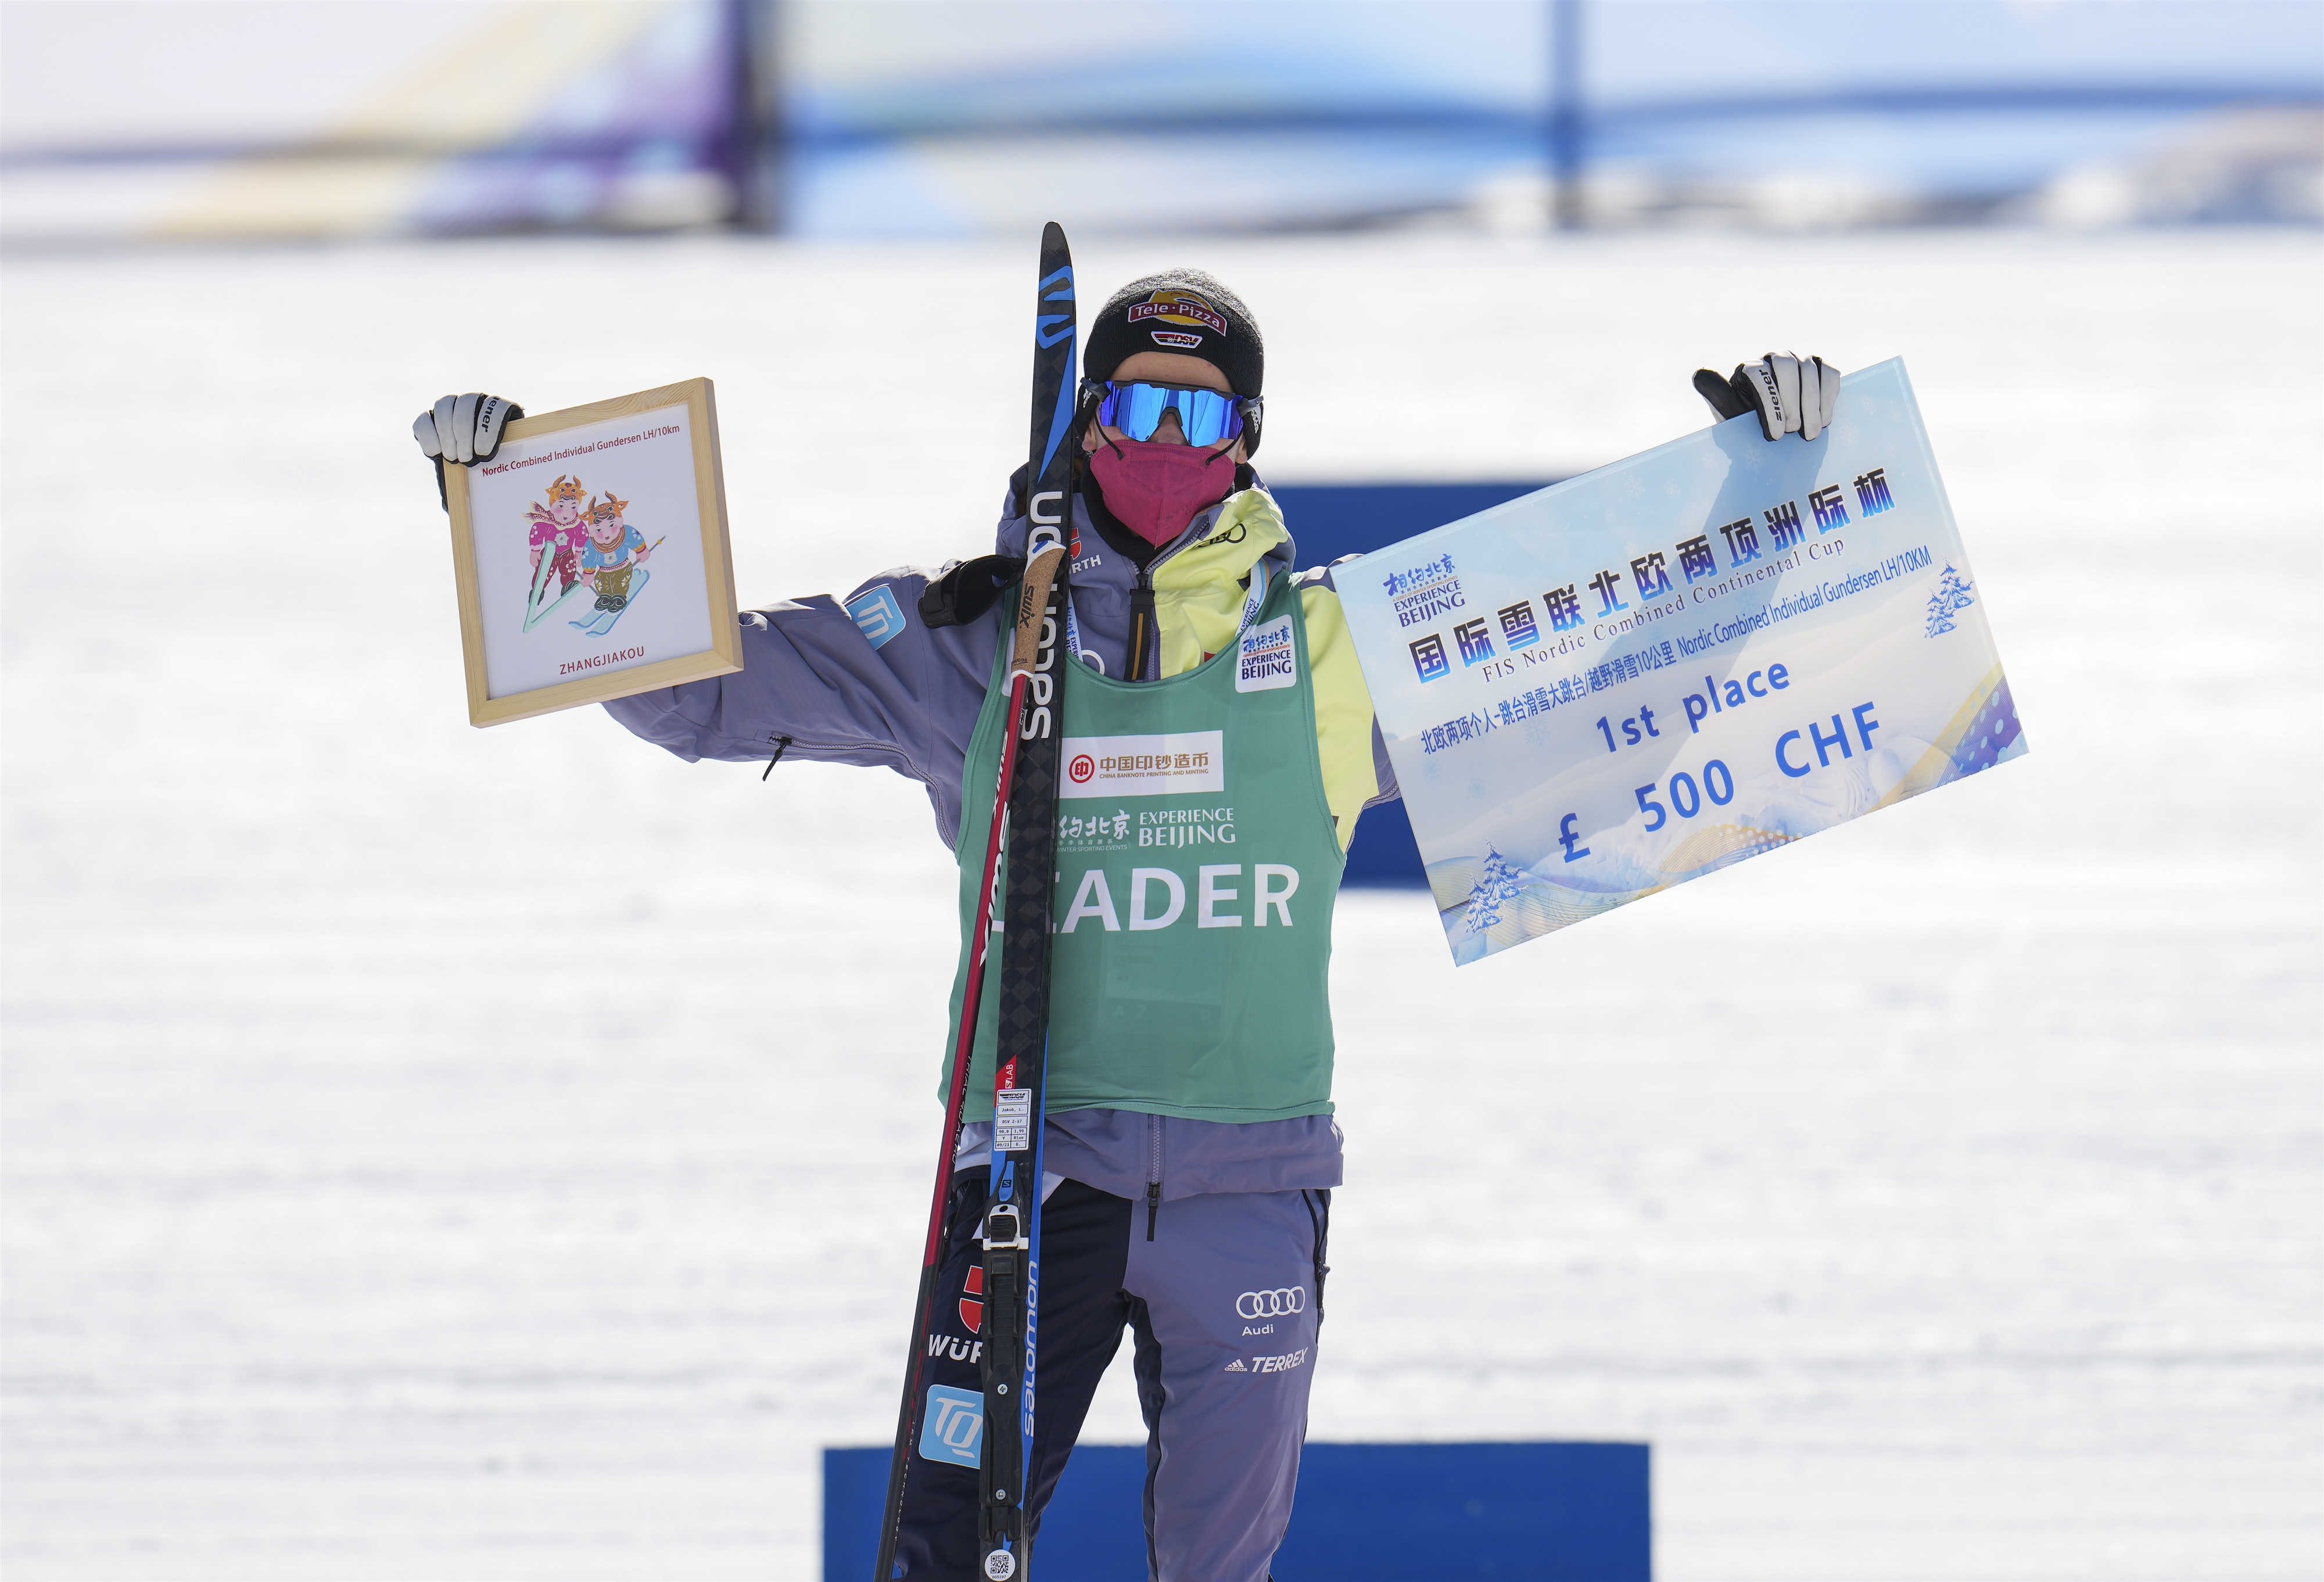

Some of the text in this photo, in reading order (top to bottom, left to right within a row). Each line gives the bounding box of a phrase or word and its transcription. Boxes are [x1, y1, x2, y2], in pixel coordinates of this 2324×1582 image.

[1135, 303, 1220, 328] Tele Pizza
[1759, 369, 1782, 421] ziener
[482, 397, 500, 433] iener
[482, 424, 680, 477] Nordic Combined Individual Gundersen LH/10km
[1070, 554, 1102, 575] RTH
[1383, 554, 1455, 597] 相约北京
[1408, 468, 1895, 684] 国际雪联北欧两项洲际杯
[1394, 580, 1461, 612] EXPERIENCE
[1426, 580, 1444, 590] SPORTING
[1677, 630, 1715, 658] Nordic
[1714, 611, 1771, 644] Combined
[1769, 584, 1824, 623] Individual
[1823, 571, 1880, 604] Gundersen
[1880, 545, 1932, 583] LH/10KM
[1020, 583, 1035, 628] swix
[1240, 598, 1254, 631] EXPERIENCE
[1398, 592, 1465, 627] BEIJING
[1482, 539, 1845, 683] FIS Nordic Combined Continental Cup
[560, 645, 645, 676] ZHANGJIAKOU
[1242, 650, 1290, 666] EXPERIENCE
[1242, 661, 1292, 680] BEIJING
[1595, 662, 1791, 753] 1st place
[1100, 752, 1208, 772] 中国印钞造币
[1558, 701, 1881, 864] £ 500 CHF
[1059, 809, 1130, 840] 约北京
[1140, 808, 1234, 824] EXPERIENCE
[1139, 824, 1236, 849] BEIJING
[991, 864, 1300, 934] ADER
[1242, 1324, 1274, 1336] Audi
[1024, 1261, 1037, 1437] salomon
[1252, 1347, 1308, 1373] TERREX
[935, 1397, 983, 1458] TQ
